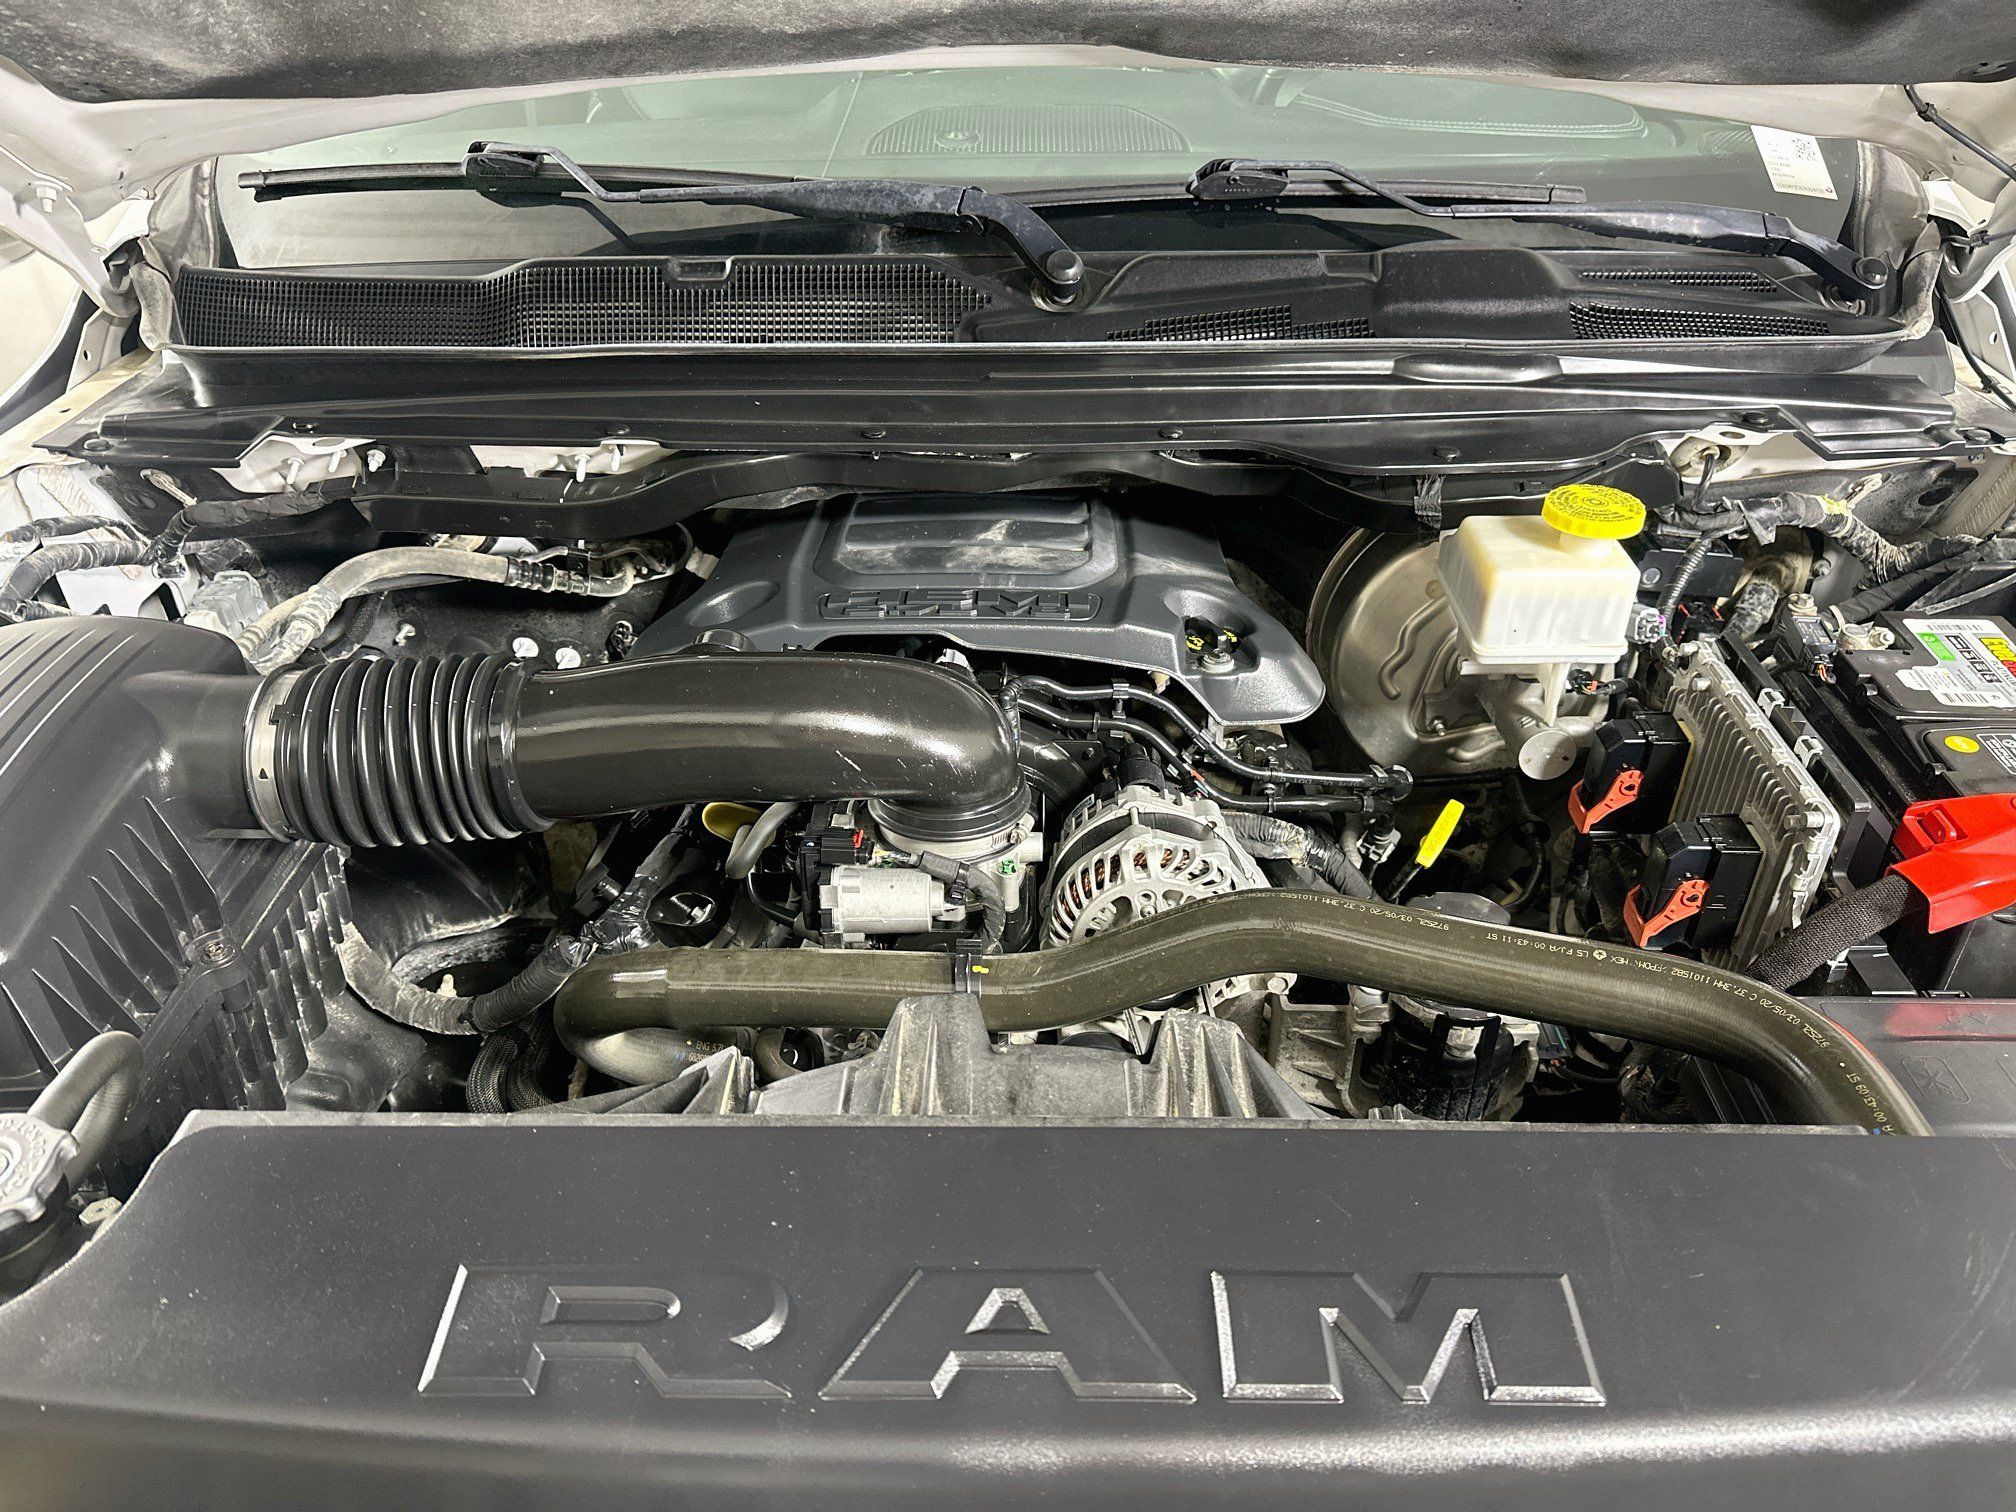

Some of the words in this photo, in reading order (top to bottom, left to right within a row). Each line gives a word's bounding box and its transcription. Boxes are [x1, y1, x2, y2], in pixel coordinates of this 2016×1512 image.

[1322, 897, 1355, 909] 37.3MM
[1369, 906, 1412, 922] 03/05/20
[1416, 917, 1449, 930] 97252L
[1485, 931, 1498, 940] ST
[1500, 934, 1546, 950] 00:43:11
[1548, 944, 1573, 955] FJ/A
[1575, 948, 1589, 957] LS
[1609, 954, 1628, 965] MEX
[1670, 966, 1710, 983] 1101582
[1712, 978, 1748, 997] 37.3MM
[1748, 991, 1758, 1001] C
[1758, 997, 1801, 1025] 03/05/20
[1801, 1022, 1830, 1048] 97252L
[696, 1040, 710, 1051] ENG
[1845, 1070, 1860, 1084] ST
[1855, 1082, 1888, 1123] 00:43:09
[417, 1264, 1606, 1406] RAM
